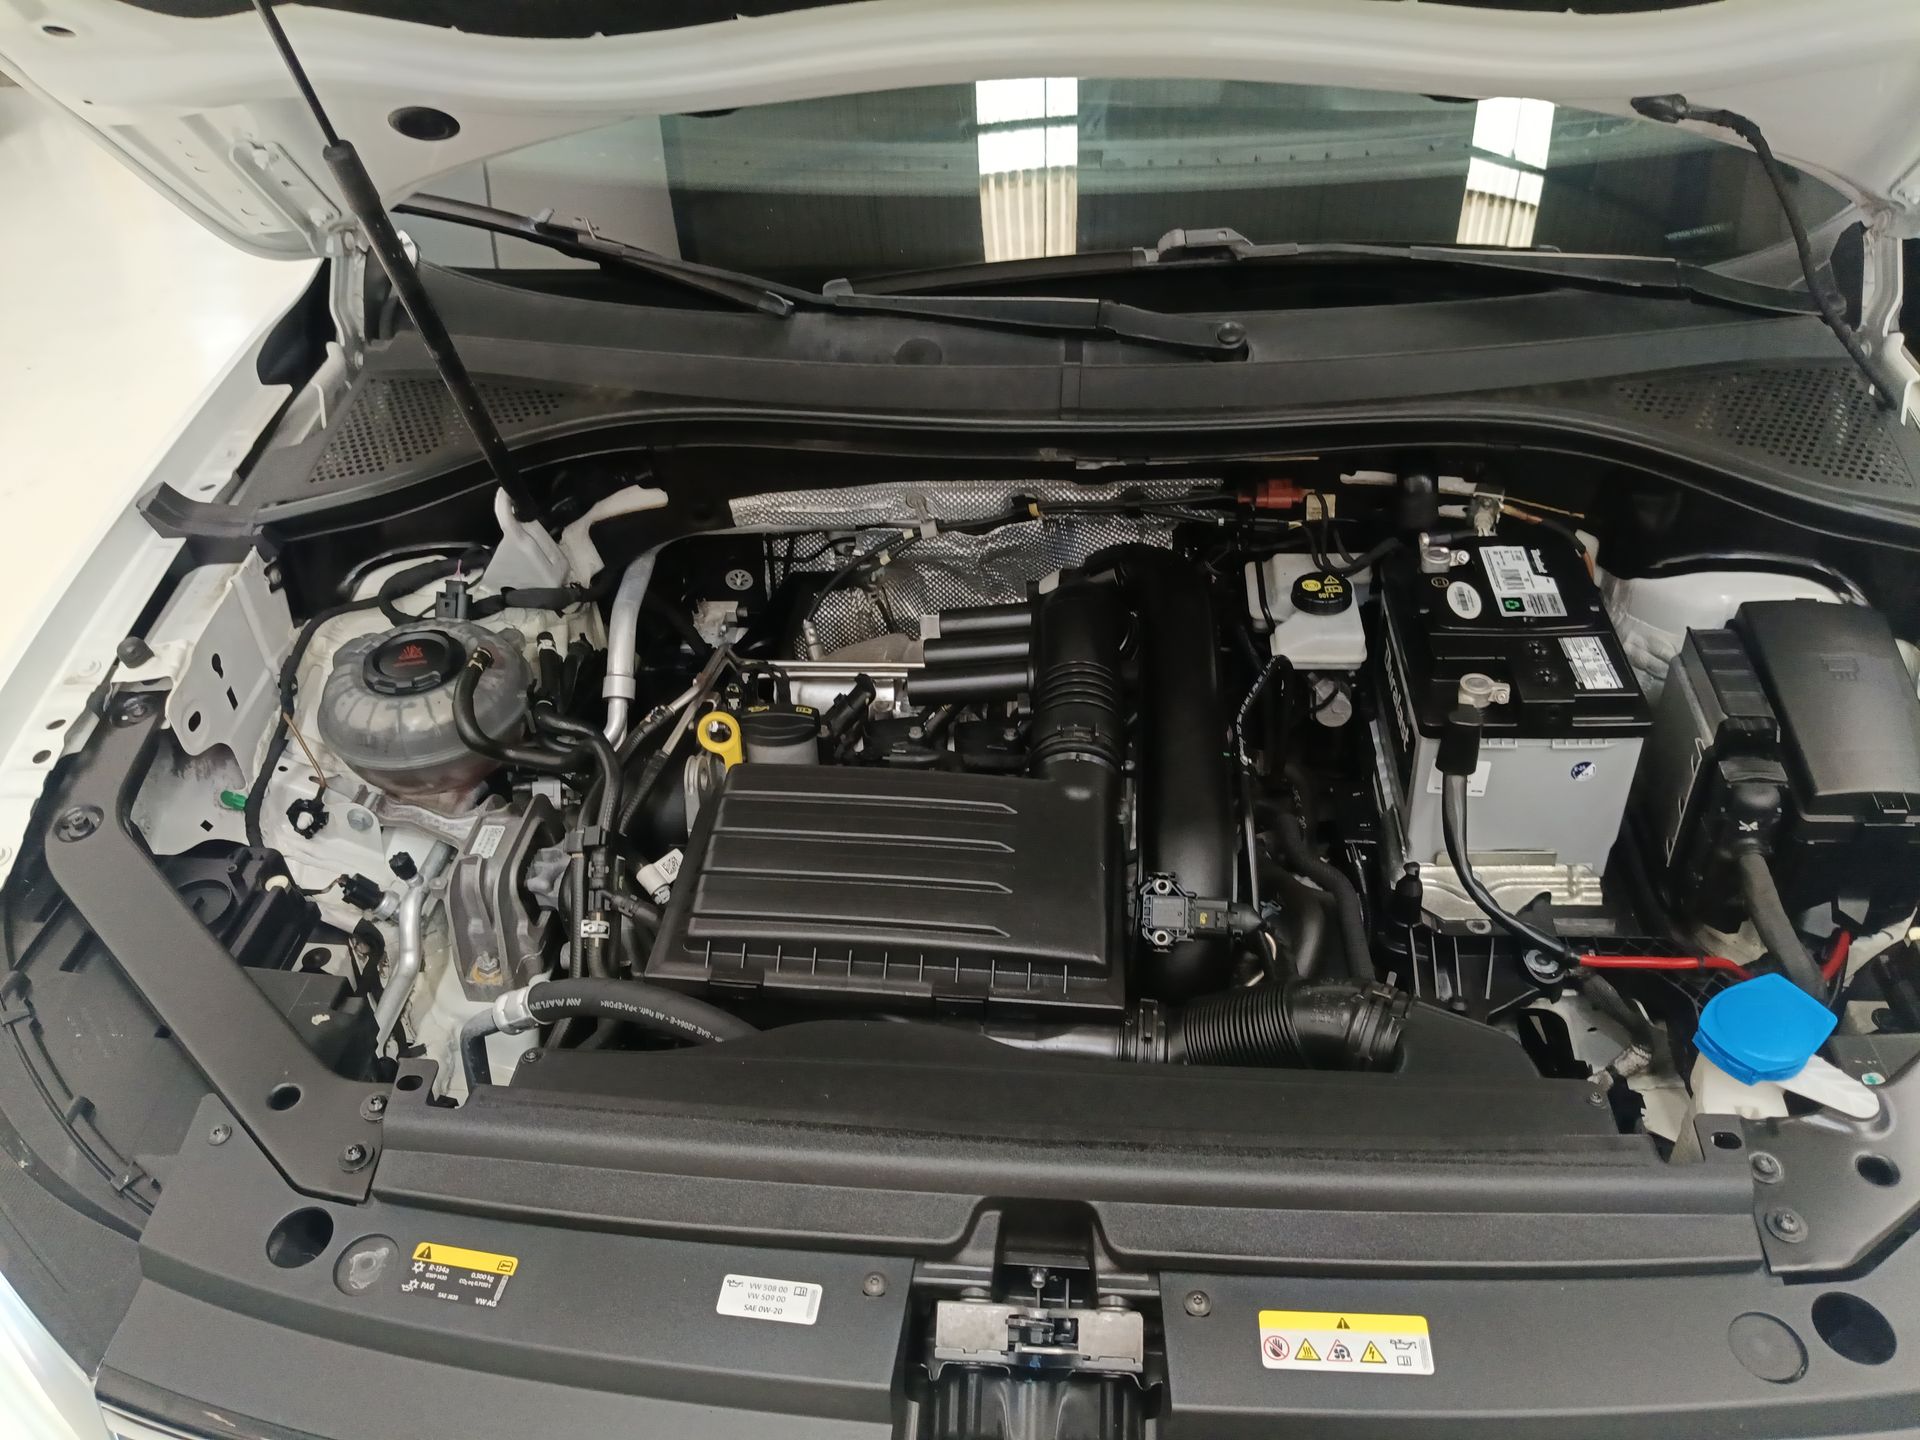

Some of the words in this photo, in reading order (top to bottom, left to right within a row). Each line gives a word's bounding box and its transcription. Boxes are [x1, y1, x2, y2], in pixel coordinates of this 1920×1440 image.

[420, 1282, 435, 1291] PAG
[749, 1282, 761, 1290] VW
[763, 1284, 777, 1292] 508
[778, 1286, 788, 1294] 00
[475, 1297, 486, 1305] VW
[486, 1299, 498, 1307] AG
[747, 1292, 760, 1300] VW
[761, 1293, 775, 1301] 509
[776, 1295, 786, 1303] 00
[744, 1303, 757, 1312] SAE
[758, 1305, 783, 1315] 0W-20
